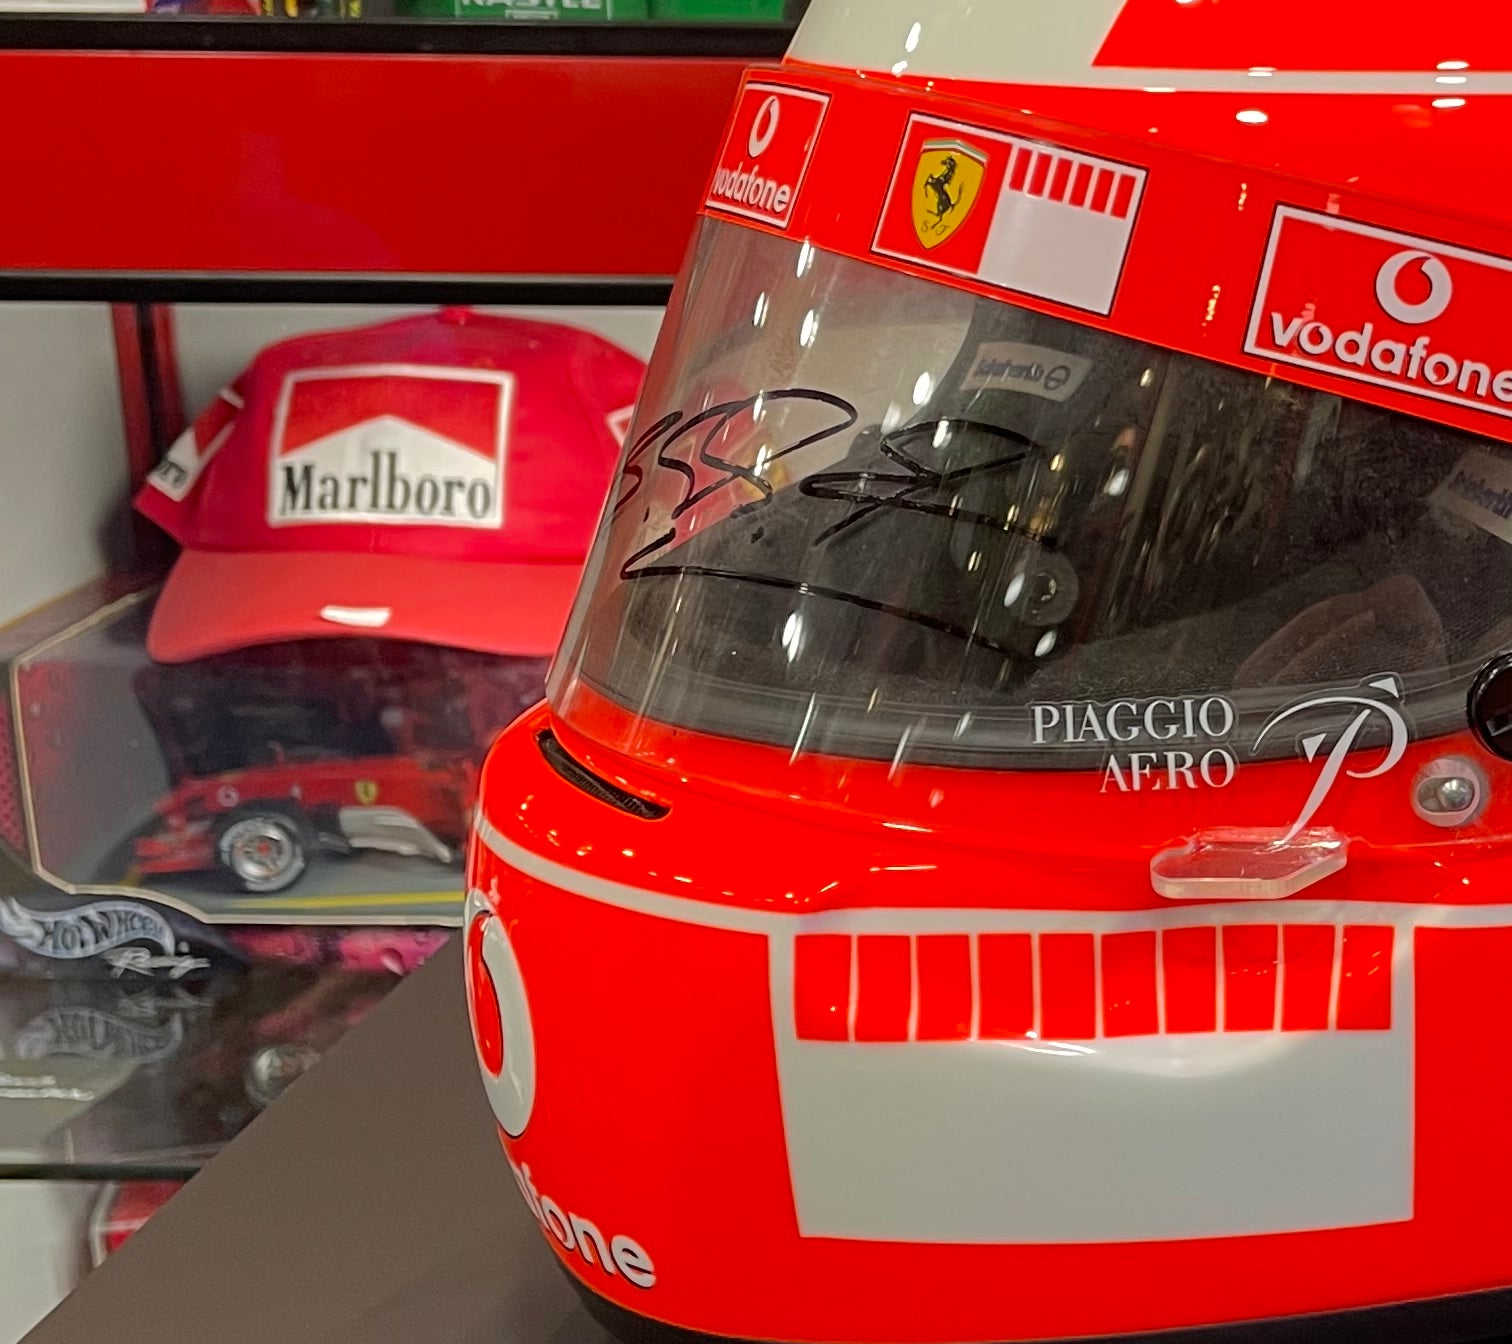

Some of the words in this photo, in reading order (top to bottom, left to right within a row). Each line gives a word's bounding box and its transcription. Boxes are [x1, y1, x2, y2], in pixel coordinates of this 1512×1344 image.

[711, 160, 792, 213] vodafone
[279, 449, 493, 520] Marlboro
[1030, 696, 1236, 745] PIAGGIO
[1098, 747, 1238, 794] AERO
